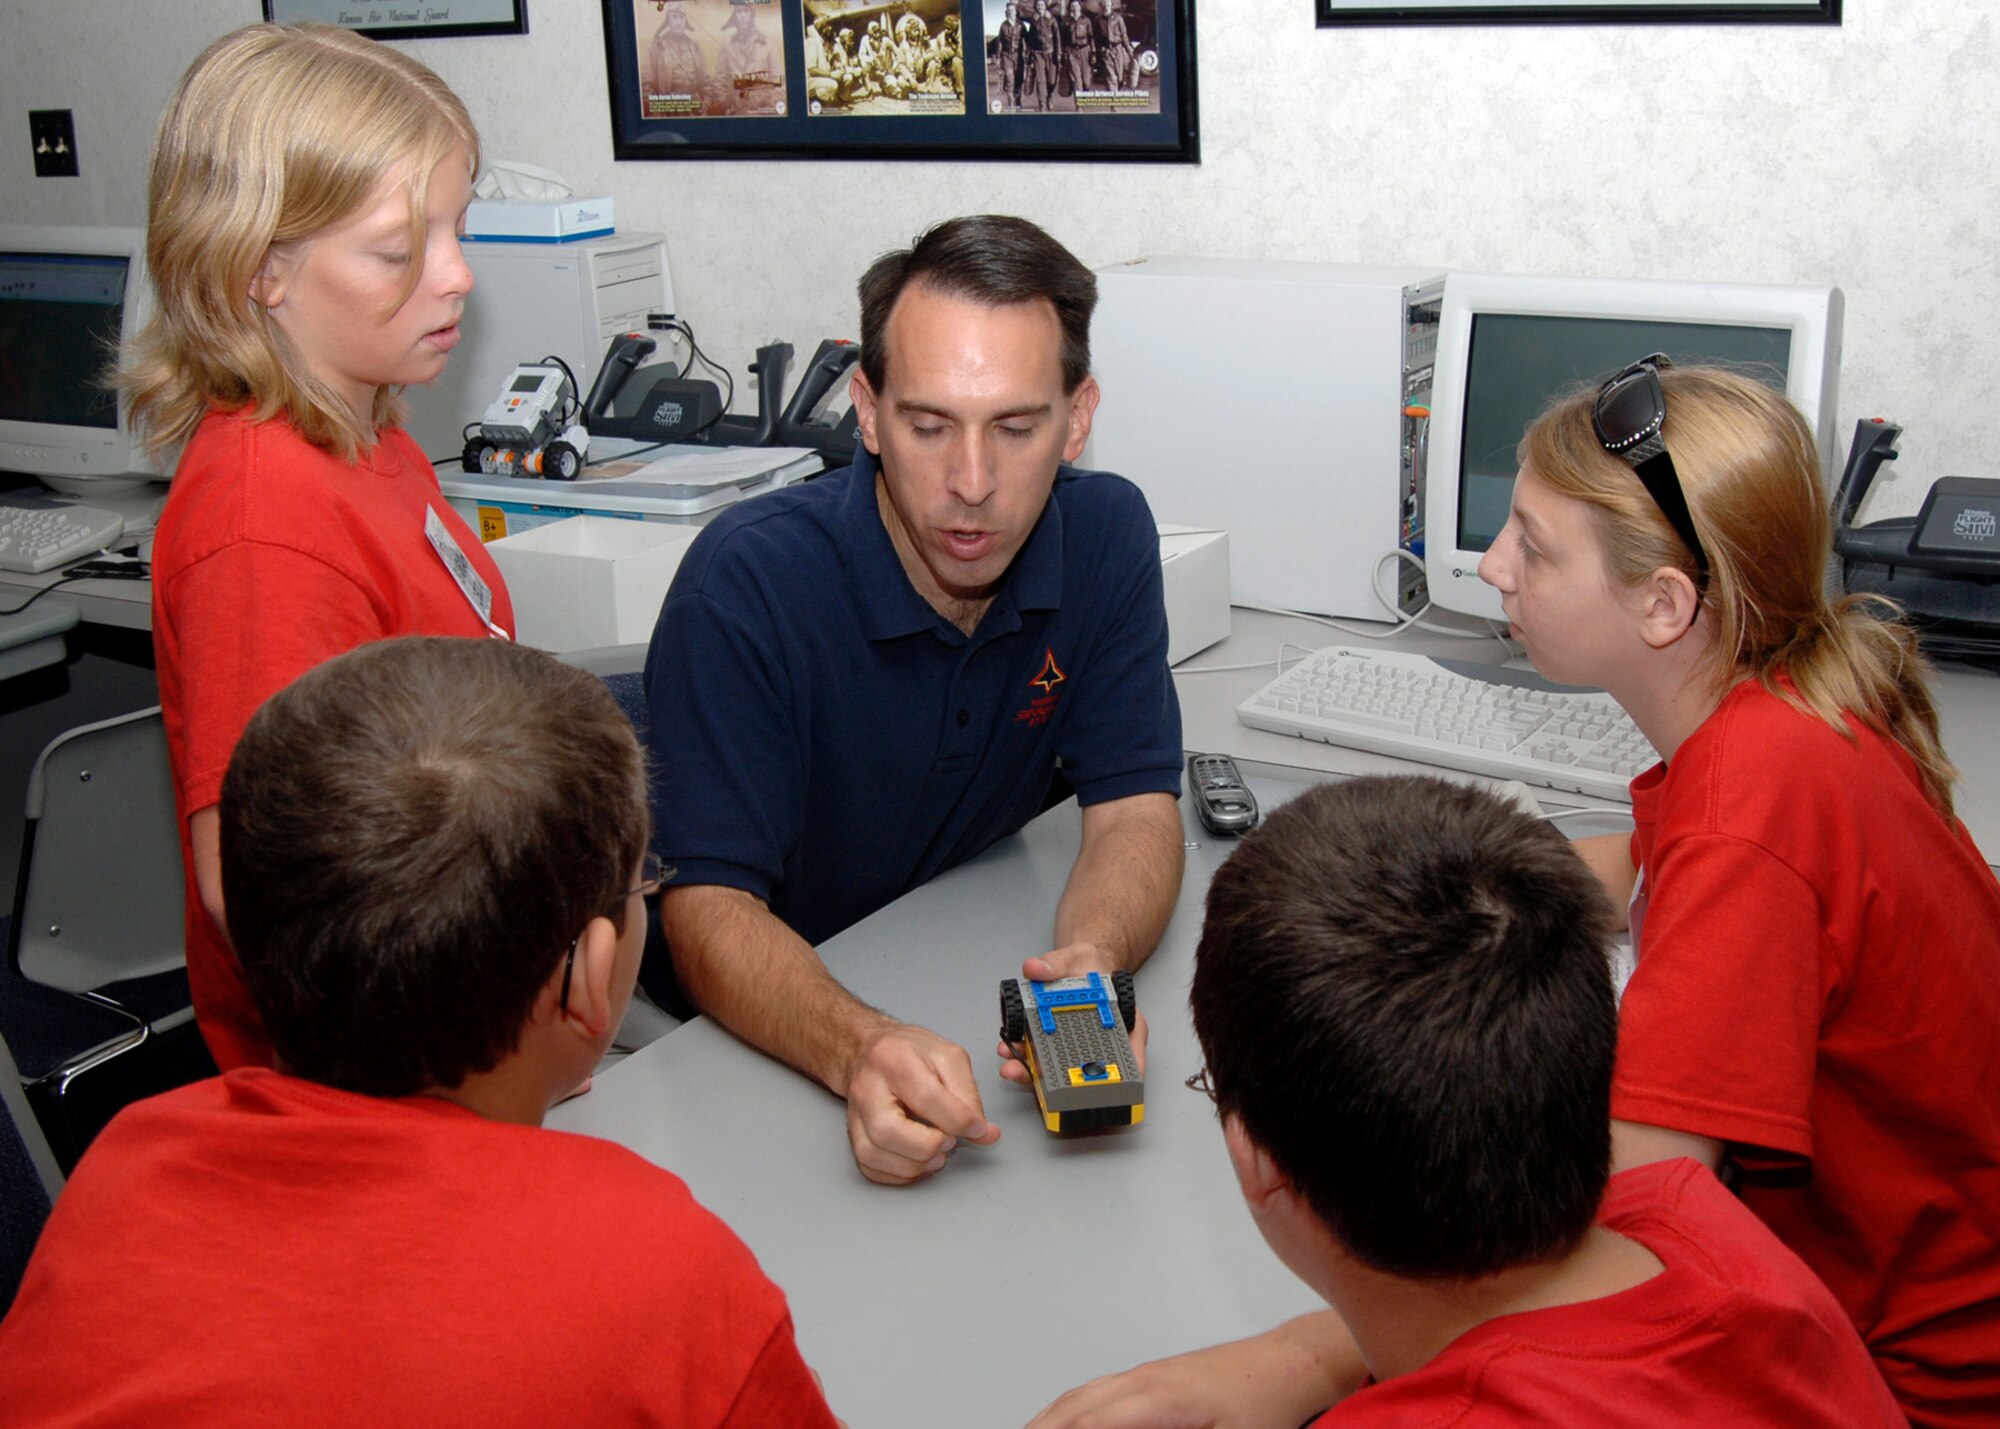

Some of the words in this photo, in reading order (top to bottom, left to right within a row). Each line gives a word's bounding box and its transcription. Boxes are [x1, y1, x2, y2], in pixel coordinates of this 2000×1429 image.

[388, 9, 421, 21] National
[424, 7, 450, 23] Guard
[483, 520, 497, 532] 8+
[1957, 514, 1995, 524] FLIGHT
[1953, 520, 1995, 536] SIM
